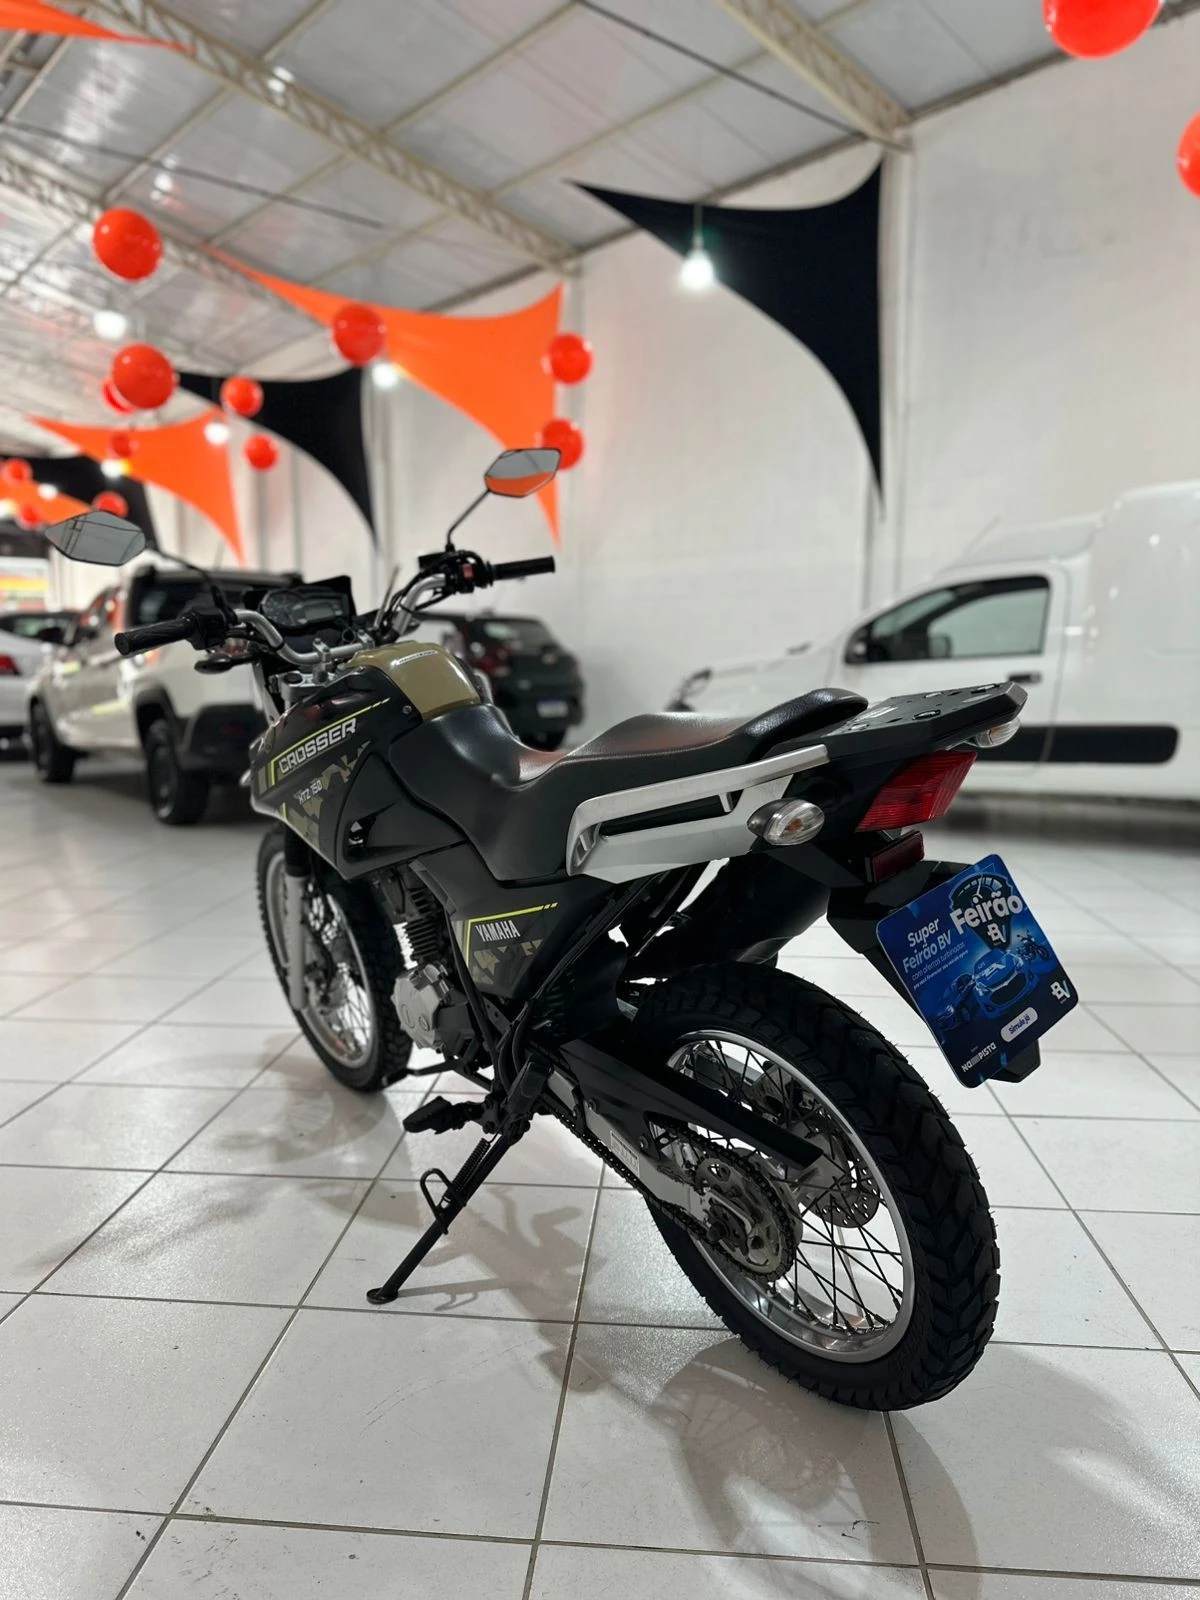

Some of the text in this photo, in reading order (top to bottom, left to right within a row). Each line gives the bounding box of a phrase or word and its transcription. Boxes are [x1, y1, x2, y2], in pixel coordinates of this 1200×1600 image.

[278, 717, 357, 774] CROSSER
[298, 779, 323, 805] XTZ 150
[949, 892, 1024, 935] Feirão
[475, 919, 521, 943] YAMAHA
[907, 918, 940, 948] Super
[902, 943, 938, 974] Feirão
[937, 929, 952, 951] BV
[911, 969, 924, 981] com
[1050, 979, 1071, 1000] BV
[1008, 1017, 1026, 1034] Simule
